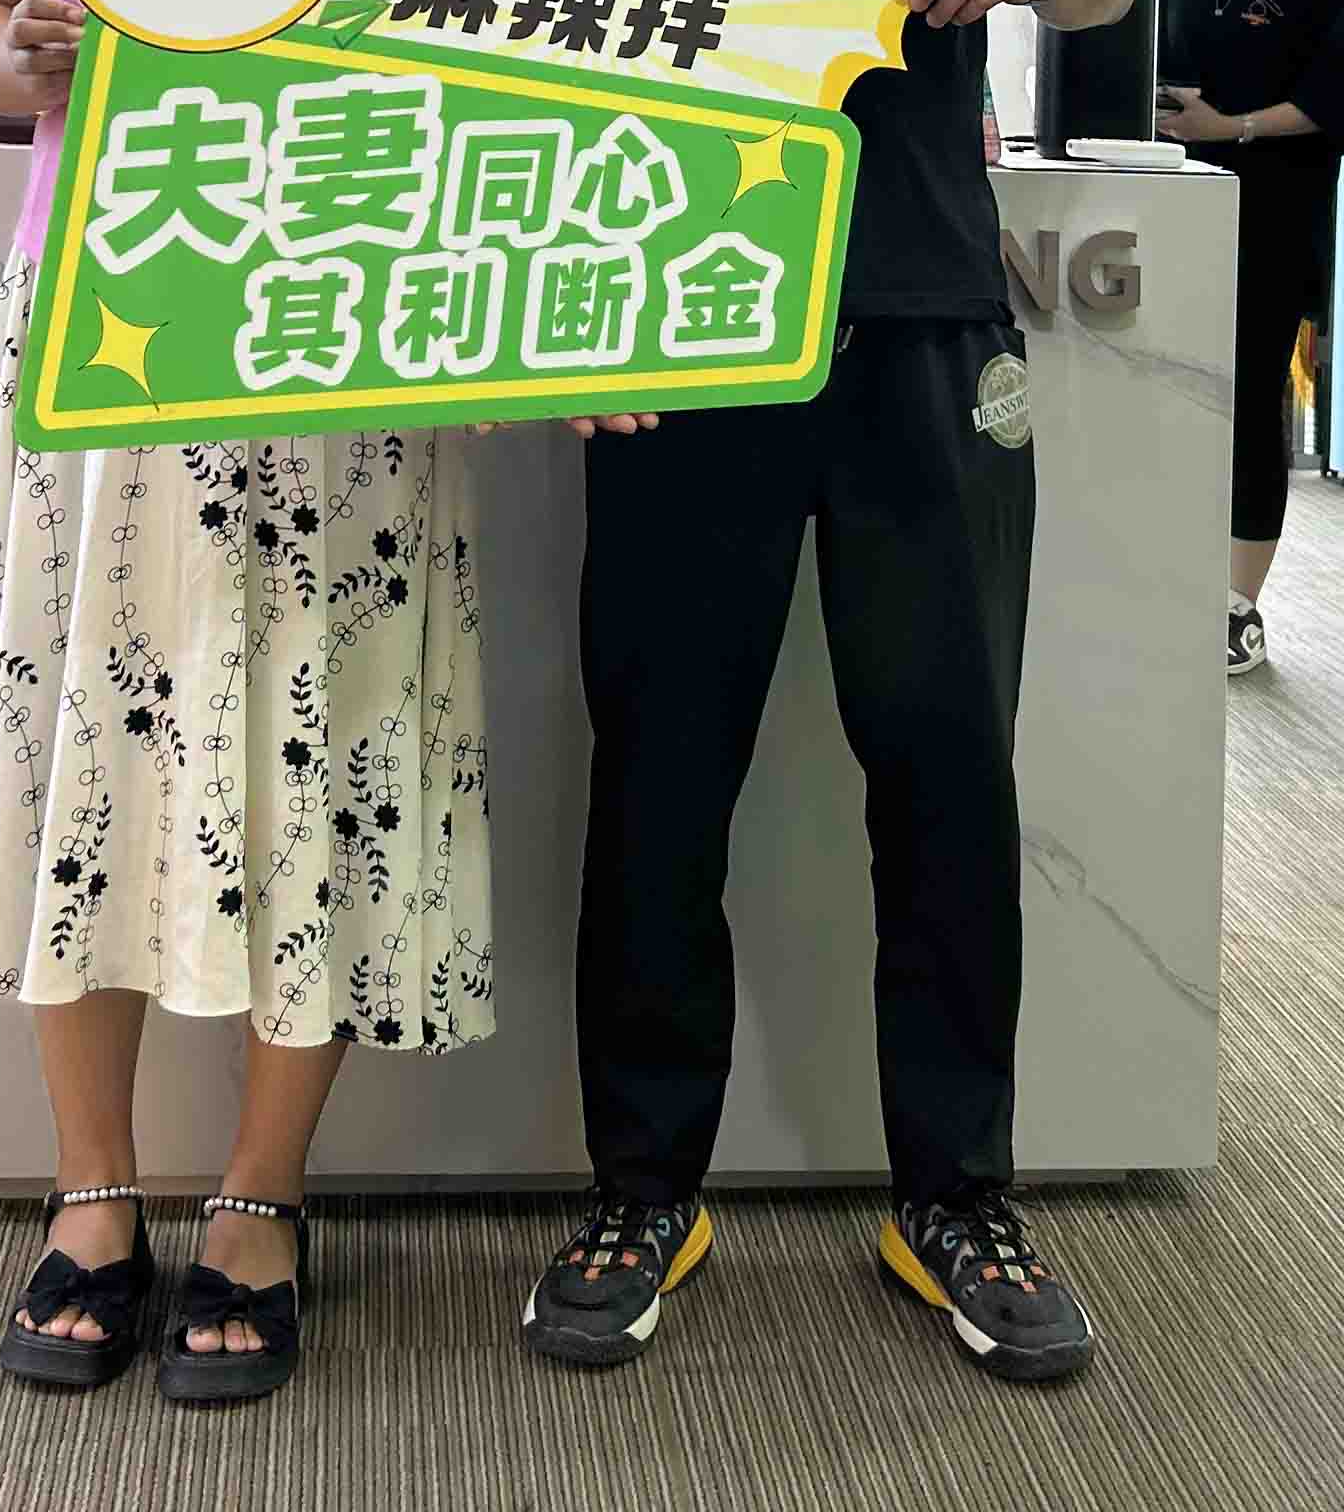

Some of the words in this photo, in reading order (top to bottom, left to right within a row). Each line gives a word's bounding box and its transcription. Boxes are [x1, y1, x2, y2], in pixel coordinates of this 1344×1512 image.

[86, 74, 687, 275] 夫妻同心
[234, 232, 786, 391] 其利断金
